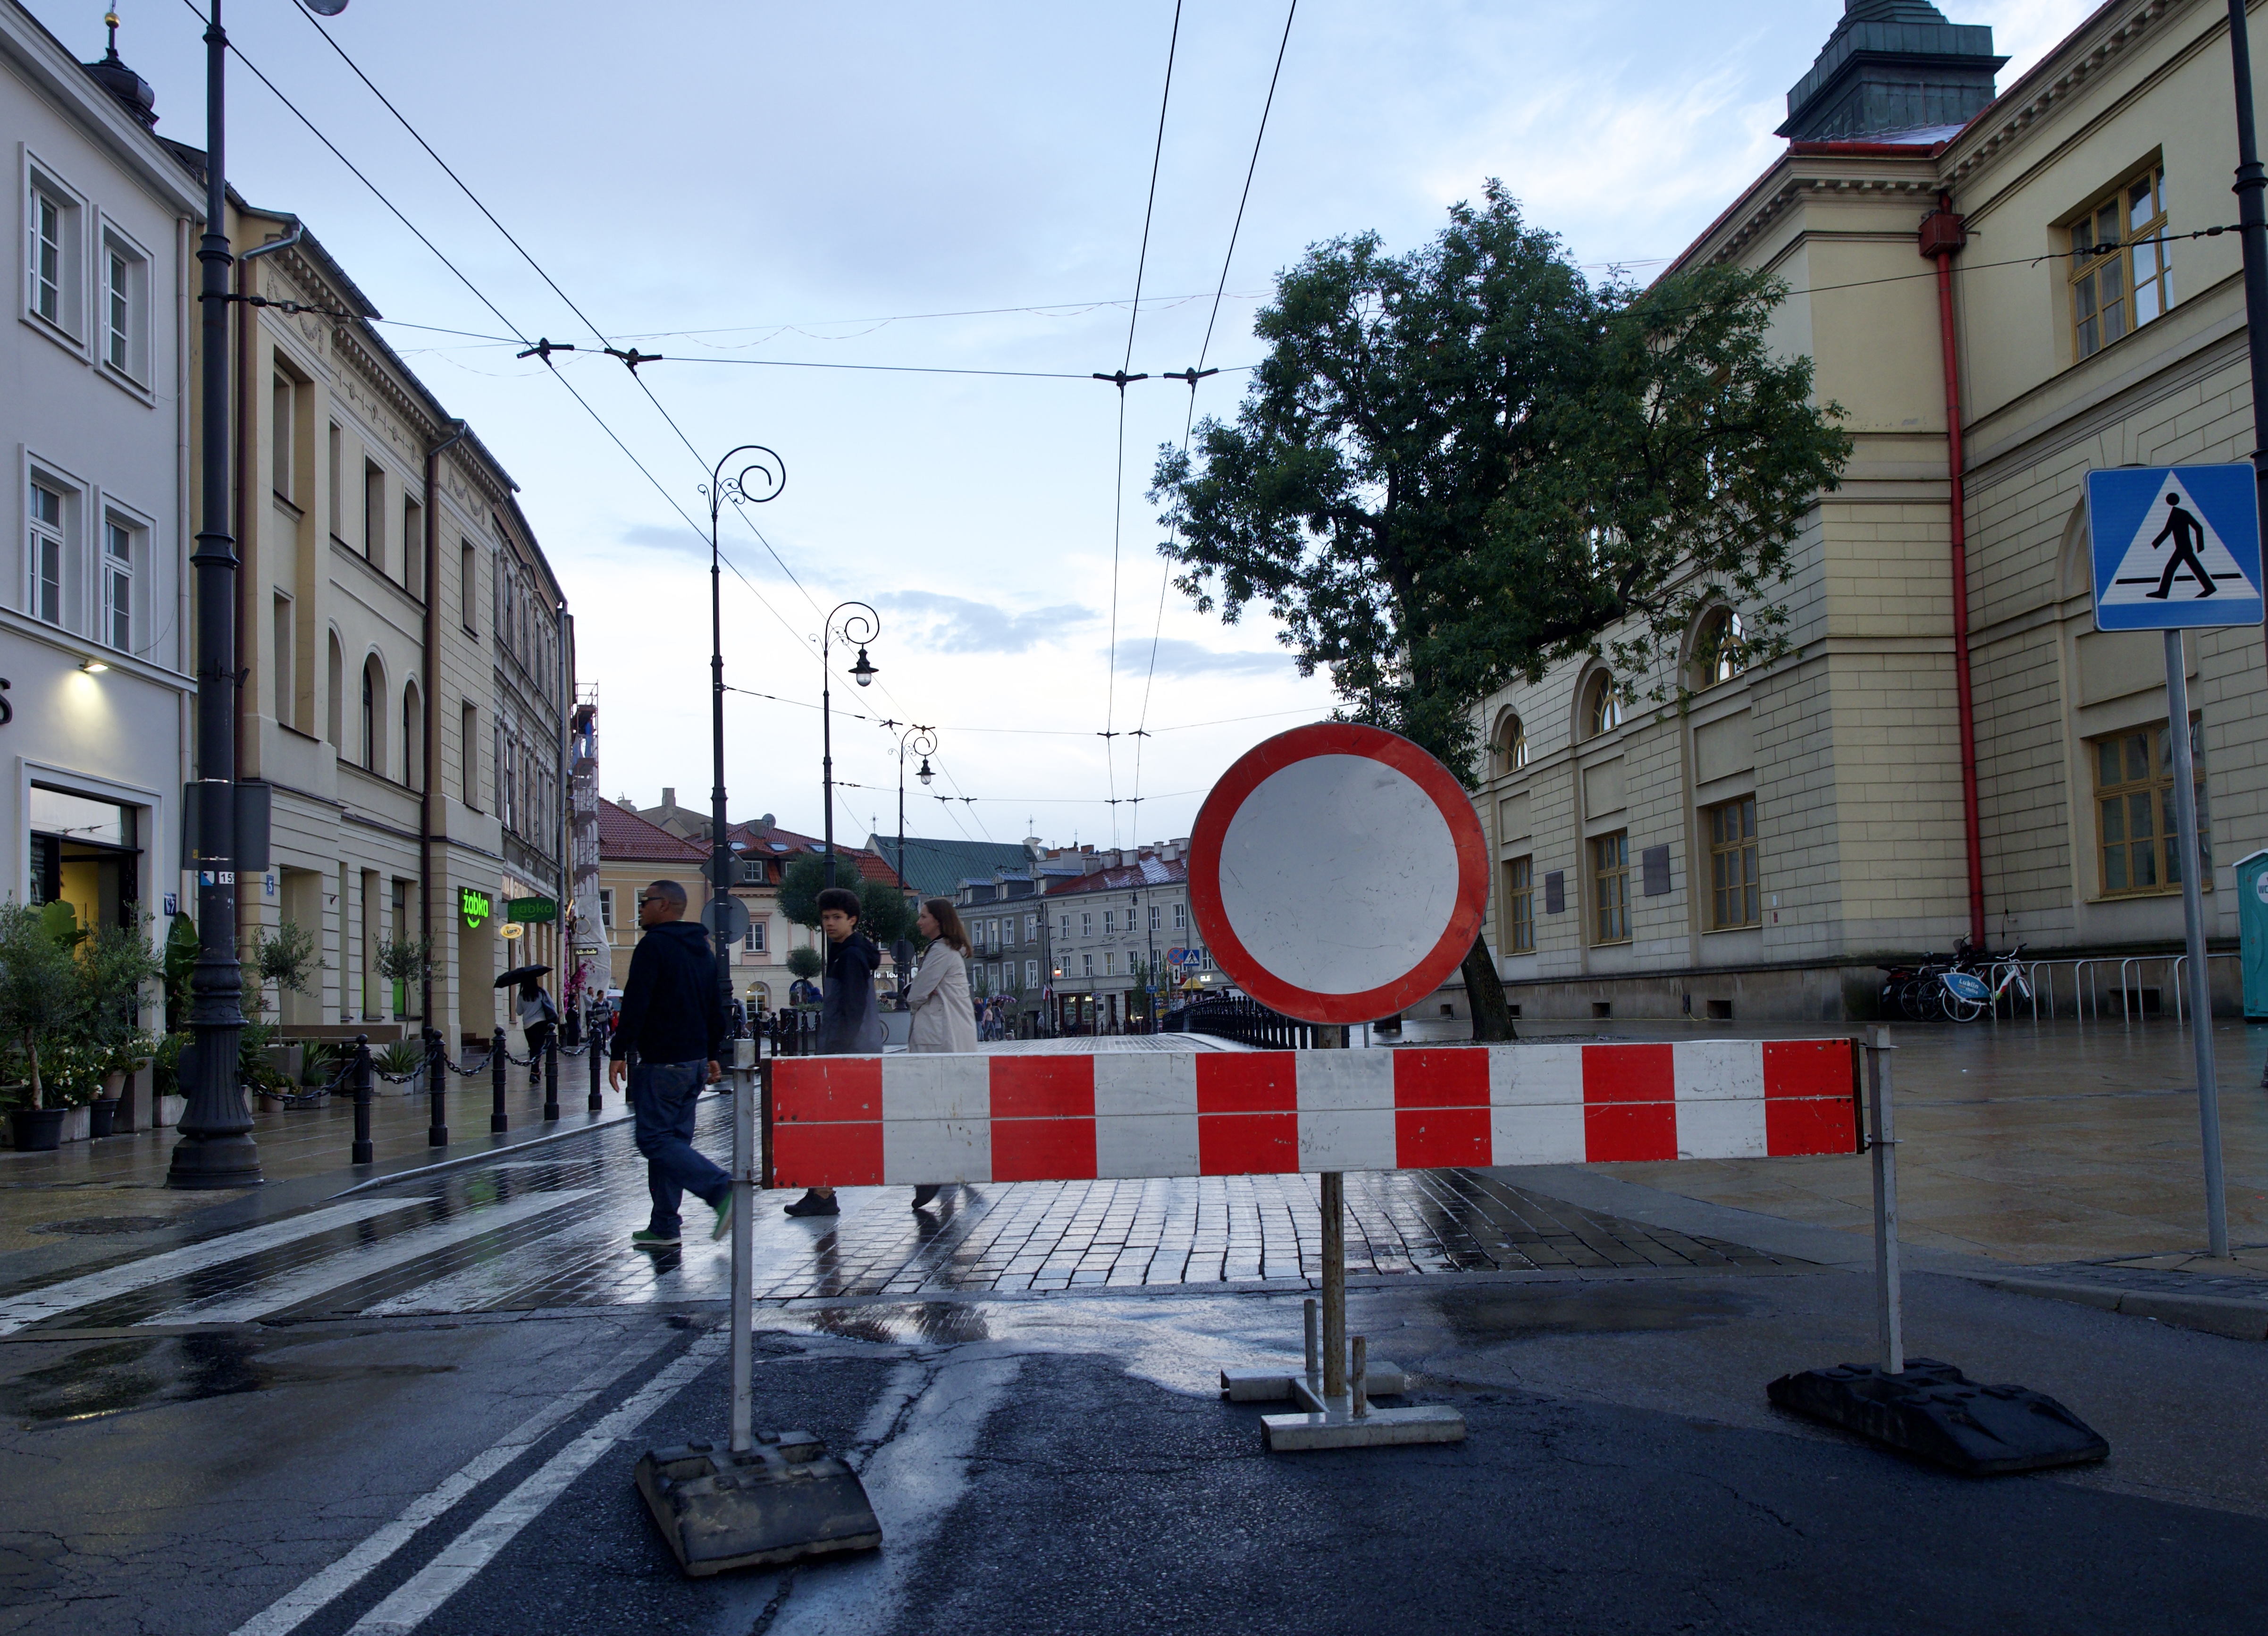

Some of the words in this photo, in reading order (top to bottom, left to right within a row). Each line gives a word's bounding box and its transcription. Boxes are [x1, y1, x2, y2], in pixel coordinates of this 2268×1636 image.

[269, 880, 273, 892] 5
[463, 888, 489, 918] żabka
[512, 902, 553, 914] żabka
[1959, 978, 1979, 989] Lublin
